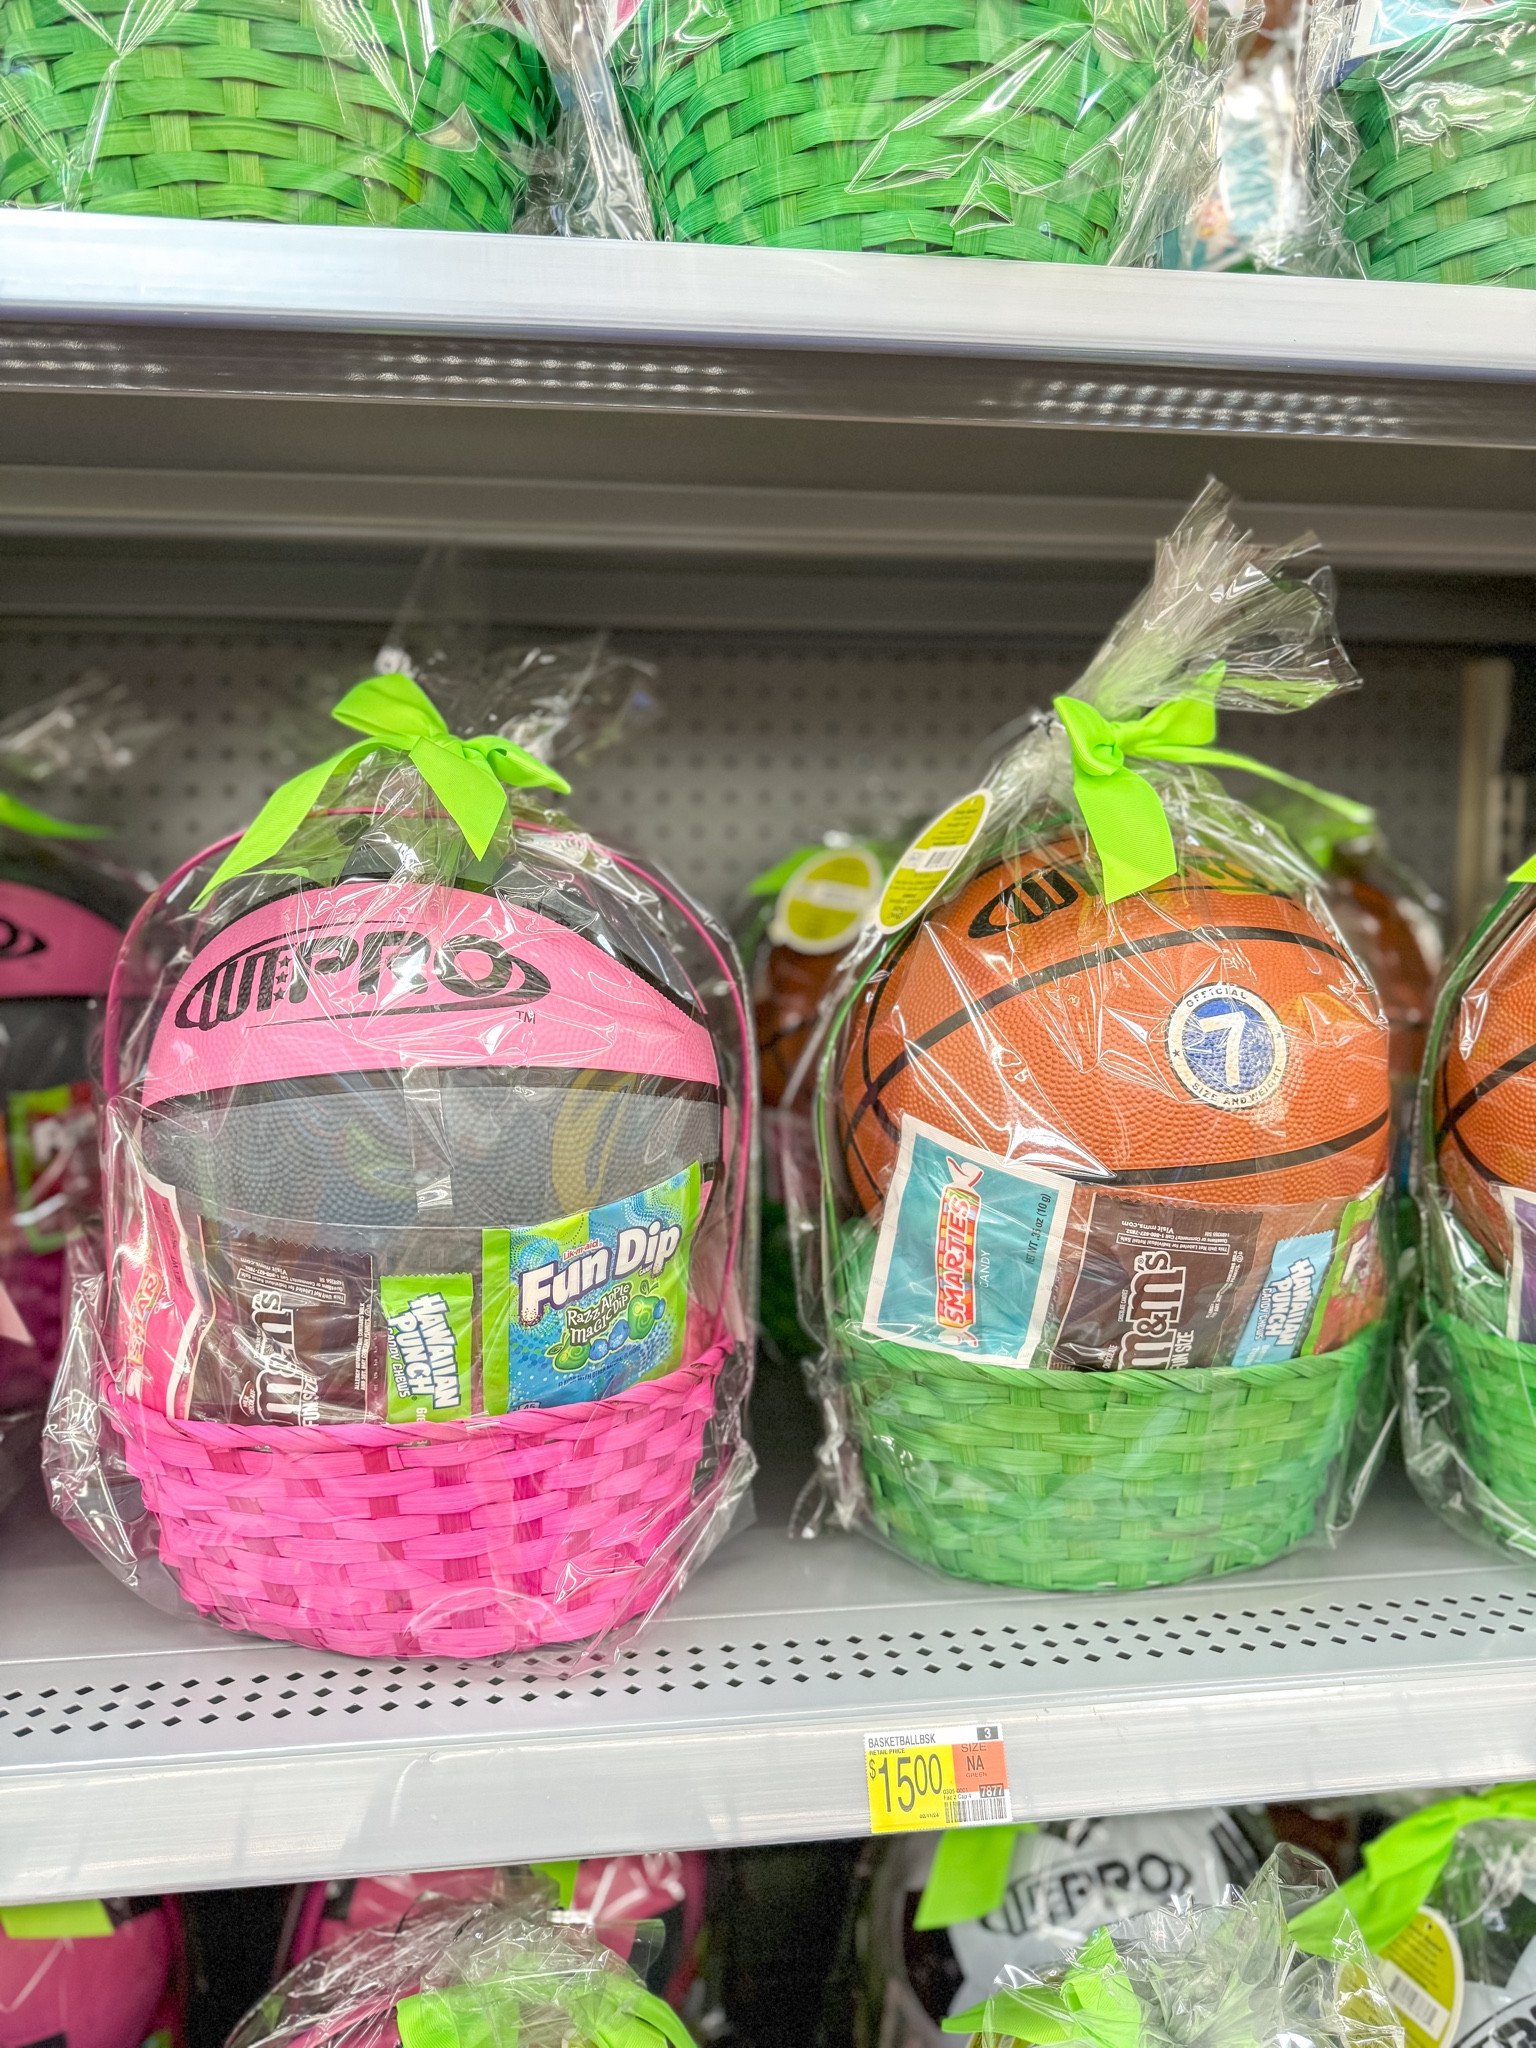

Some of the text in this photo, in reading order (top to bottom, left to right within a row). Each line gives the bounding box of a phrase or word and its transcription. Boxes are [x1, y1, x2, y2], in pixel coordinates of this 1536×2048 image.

[1186, 988, 1247, 1008] OFFICIAL
[1199, 1011, 1246, 1086] 7
[1191, 1065, 1282, 1105] SIZE AND WEIGHT
[1035, 1218, 1044, 1228] oz
[1121, 1221, 1175, 1234] Visit mms.com
[519, 1218, 682, 1328] Fun Dip
[943, 1194, 971, 1326] SMARTIES
[979, 1249, 991, 1288] CANDY
[1259, 1287, 1272, 1313] CANDY
[1264, 1275, 1294, 1337] PUNCH
[1275, 1257, 1316, 1346] HAWAIIAN
[1255, 1312, 1268, 1340] CHEWS
[387, 1310, 435, 1396] PUNCH
[408, 1292, 462, 1410] HAWAIIAN
[1170, 1329, 1194, 1369] UN SIZE
[392, 1363, 411, 1398] CHEWS
[302, 1399, 321, 1427] FUN
[868, 1733, 936, 1748] BASKETBALLBSK
[961, 1743, 987, 1752] SIZE
[984, 1727, 991, 1739] 3
[966, 1755, 985, 1771] NA
[980, 1785, 1003, 1798] 7877
